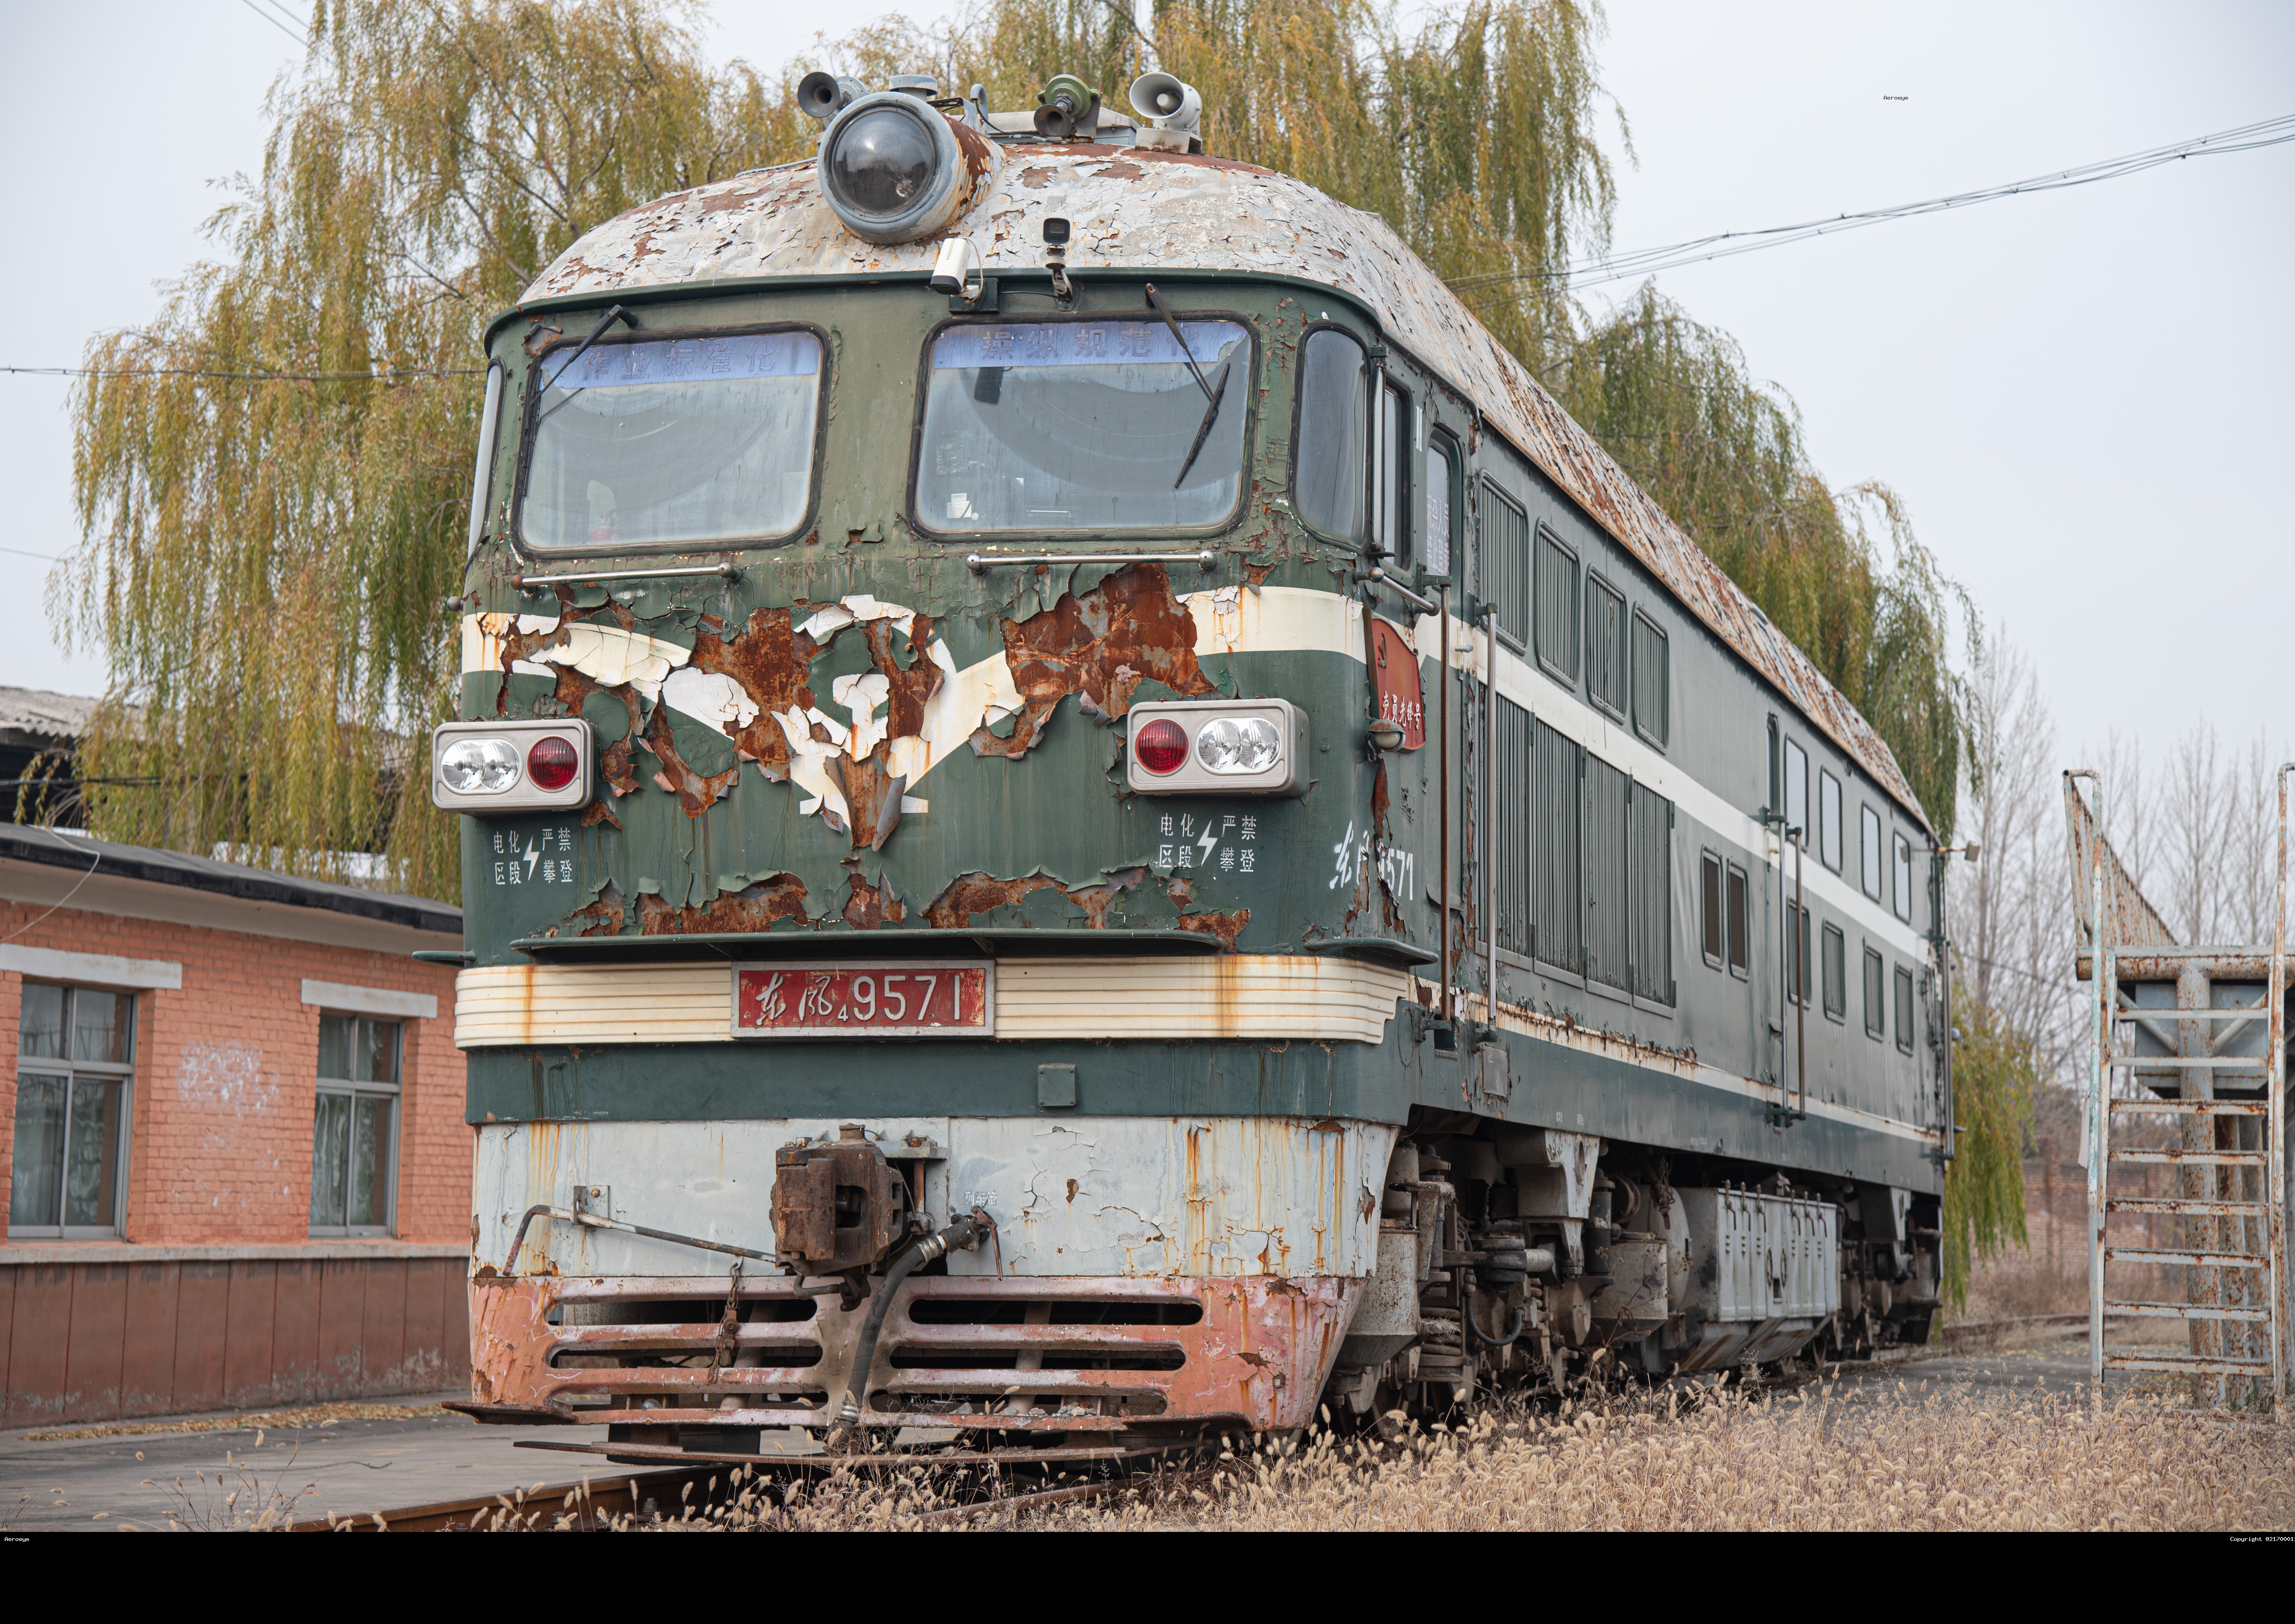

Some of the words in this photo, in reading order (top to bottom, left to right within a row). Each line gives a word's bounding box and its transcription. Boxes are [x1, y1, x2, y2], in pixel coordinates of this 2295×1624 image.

[582, 342, 776, 381] 作业标准化
[1383, 691, 1421, 730] 党员先锋号
[1161, 813, 1195, 837] 电化
[1222, 815, 1256, 840] 严禁
[494, 830, 520, 854] 电化
[542, 827, 571, 851] 严禁
[1159, 844, 1192, 869] 区段
[1220, 846, 1255, 872] 攀登
[495, 861, 521, 885] 区段
[543, 859, 572, 883] 攀登
[965, 1191, 997, 1205] 列车管
